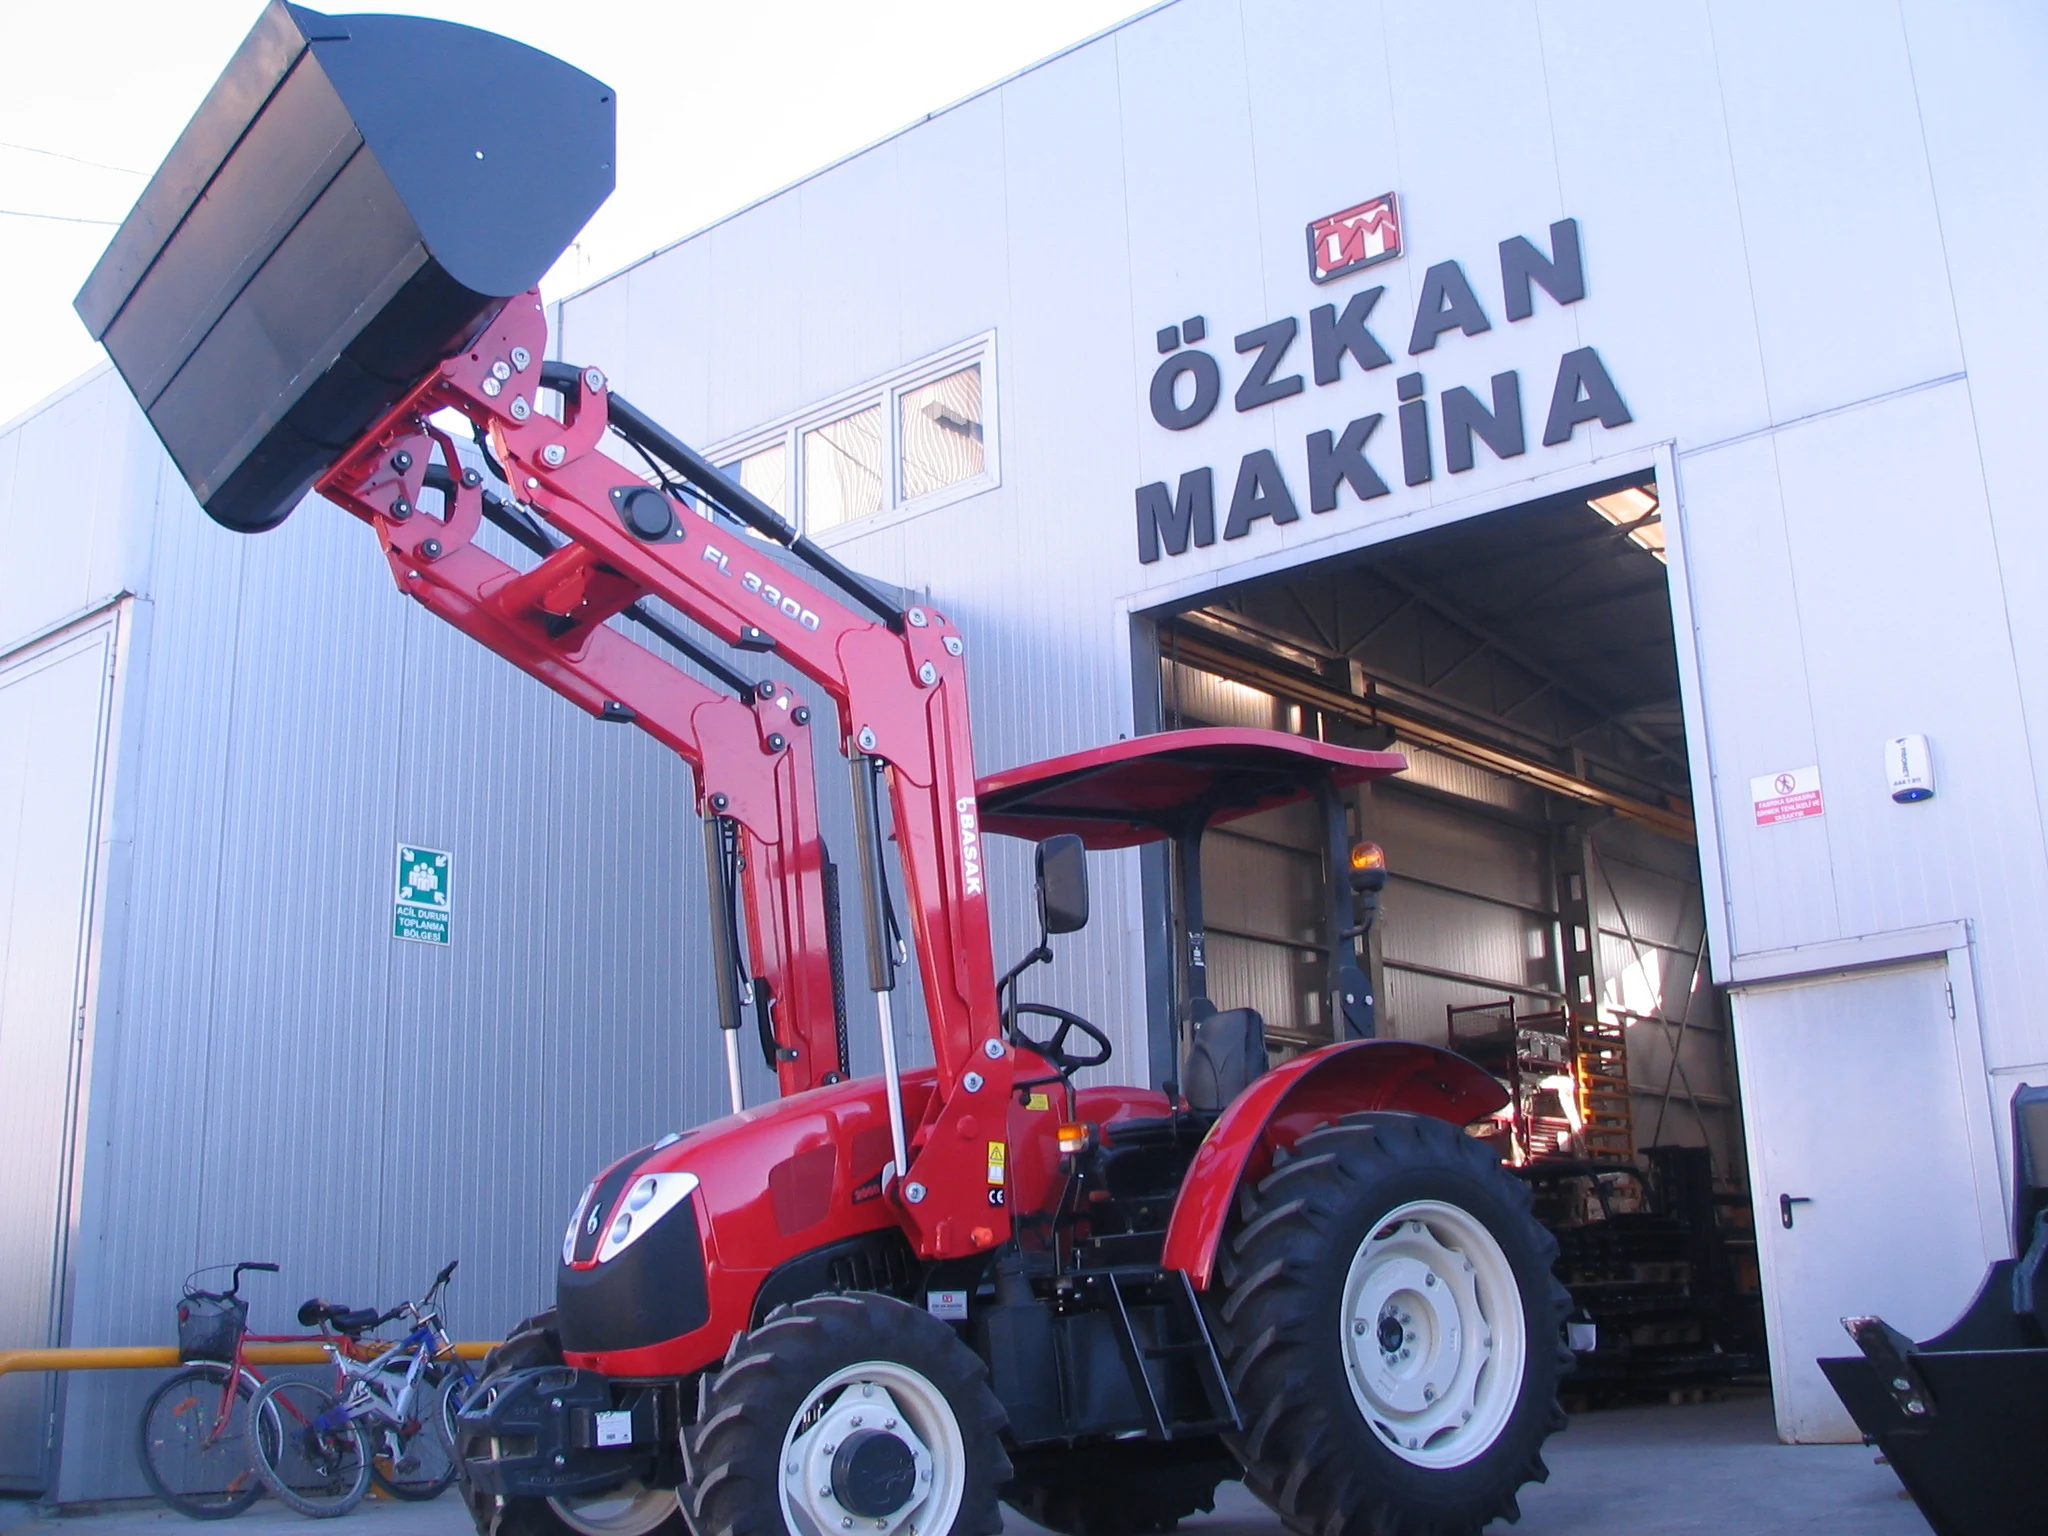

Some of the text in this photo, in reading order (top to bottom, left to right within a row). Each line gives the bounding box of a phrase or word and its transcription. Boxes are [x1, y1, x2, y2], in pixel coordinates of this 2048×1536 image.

[1150, 218, 1584, 430] ÖZKAN
[1136, 346, 1633, 565] MAKİNA
[702, 544, 821, 632] FL 3300
[397, 906, 448, 922] ACİL DURUM
[399, 917, 445, 932] TOPLANMA
